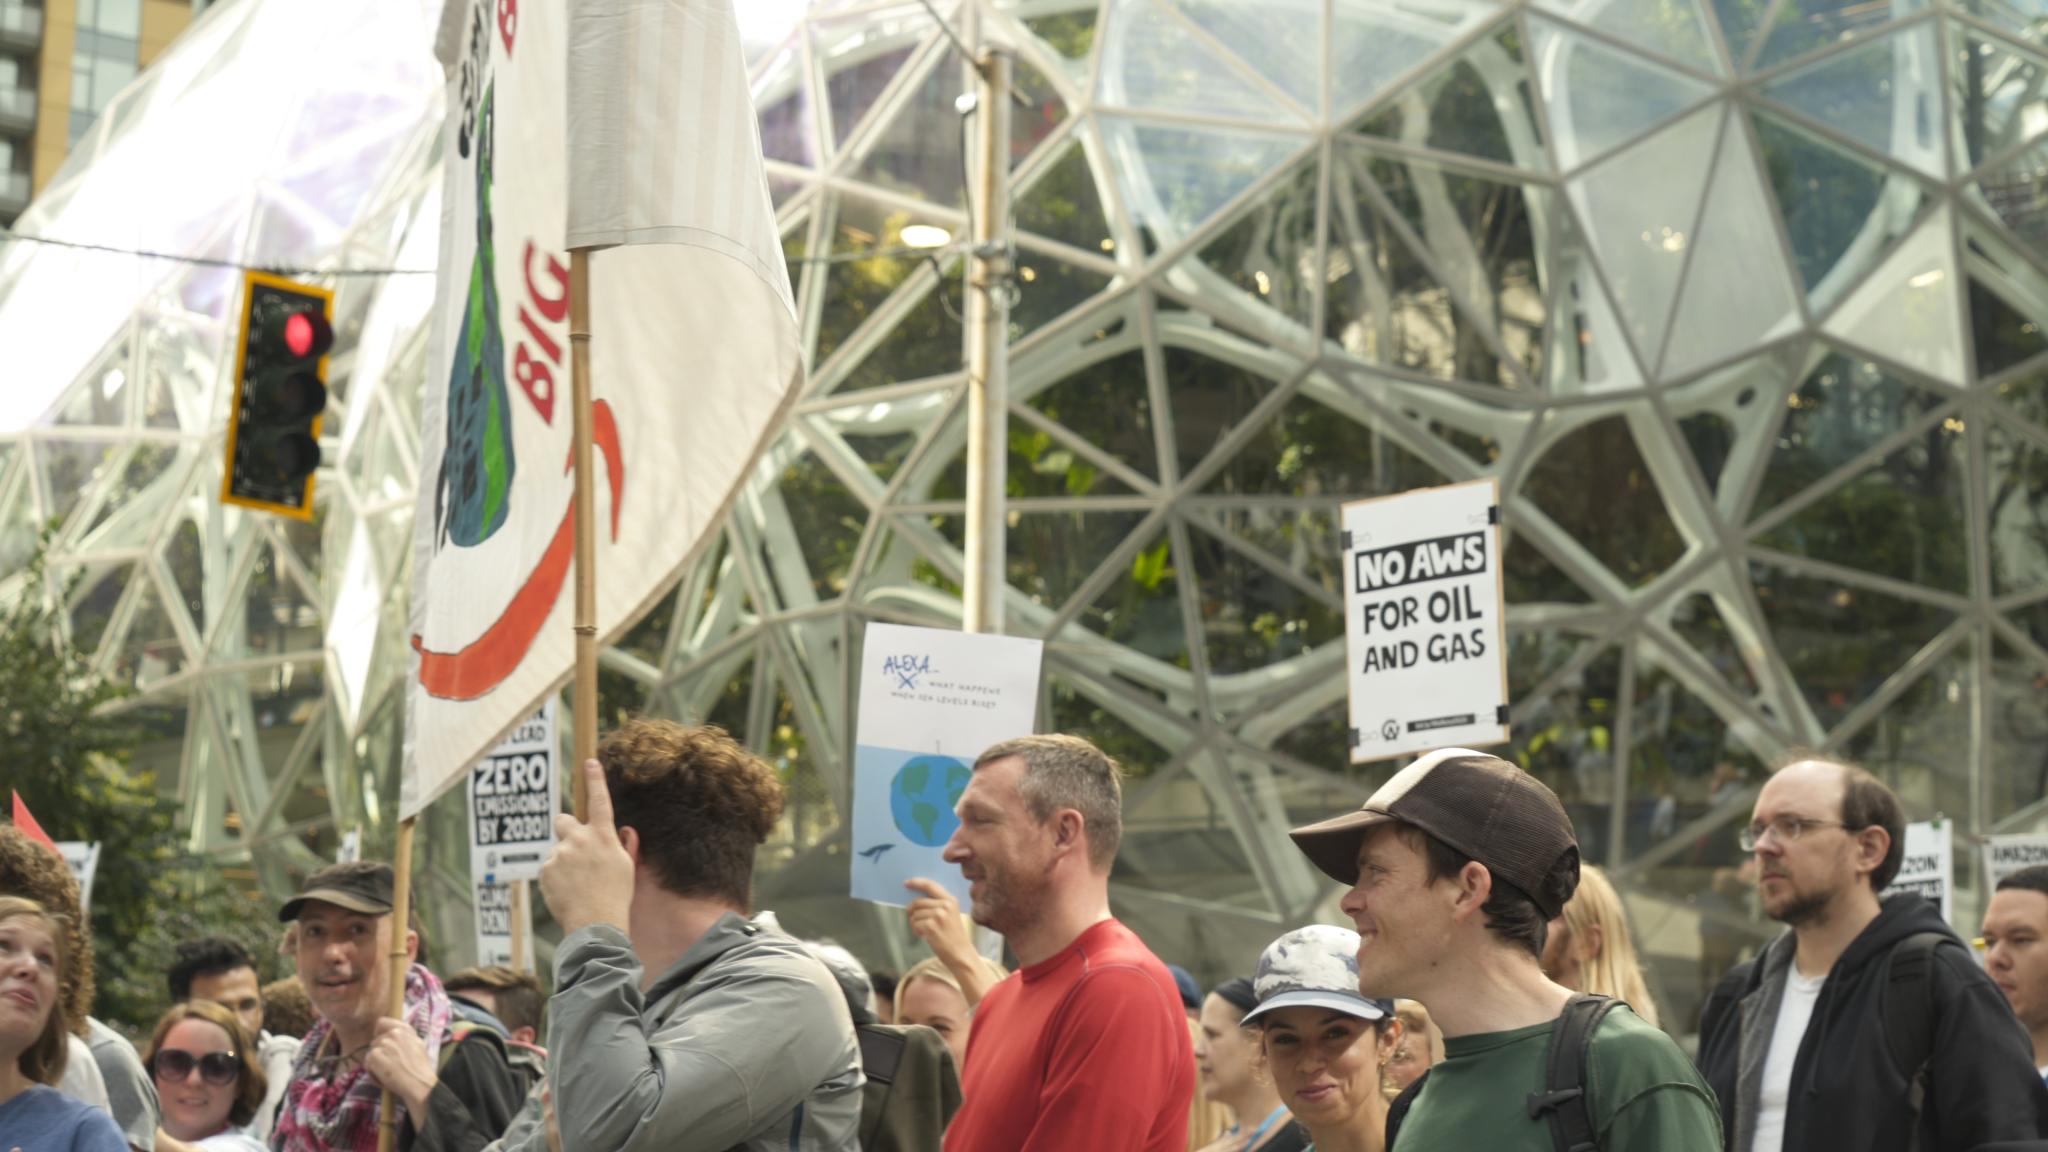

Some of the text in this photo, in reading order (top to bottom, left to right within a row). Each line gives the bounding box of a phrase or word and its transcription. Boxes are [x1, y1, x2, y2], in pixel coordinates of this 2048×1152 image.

[514, 240, 571, 426] BIG
[1357, 535, 1485, 590] NO AWS
[1364, 584, 1483, 635] FOR OIL
[1363, 628, 1486, 674] AND GAS
[890, 690, 915, 700] WHEN
[918, 693, 934, 703] SEA
[937, 696, 969, 706] LEVELS
[929, 680, 955, 690] WHAT
[958, 684, 1001, 696] HAPPENS
[474, 754, 548, 795] ZERO
[476, 792, 548, 816] EMISSIONS
[479, 815, 549, 844] BY 2030!
